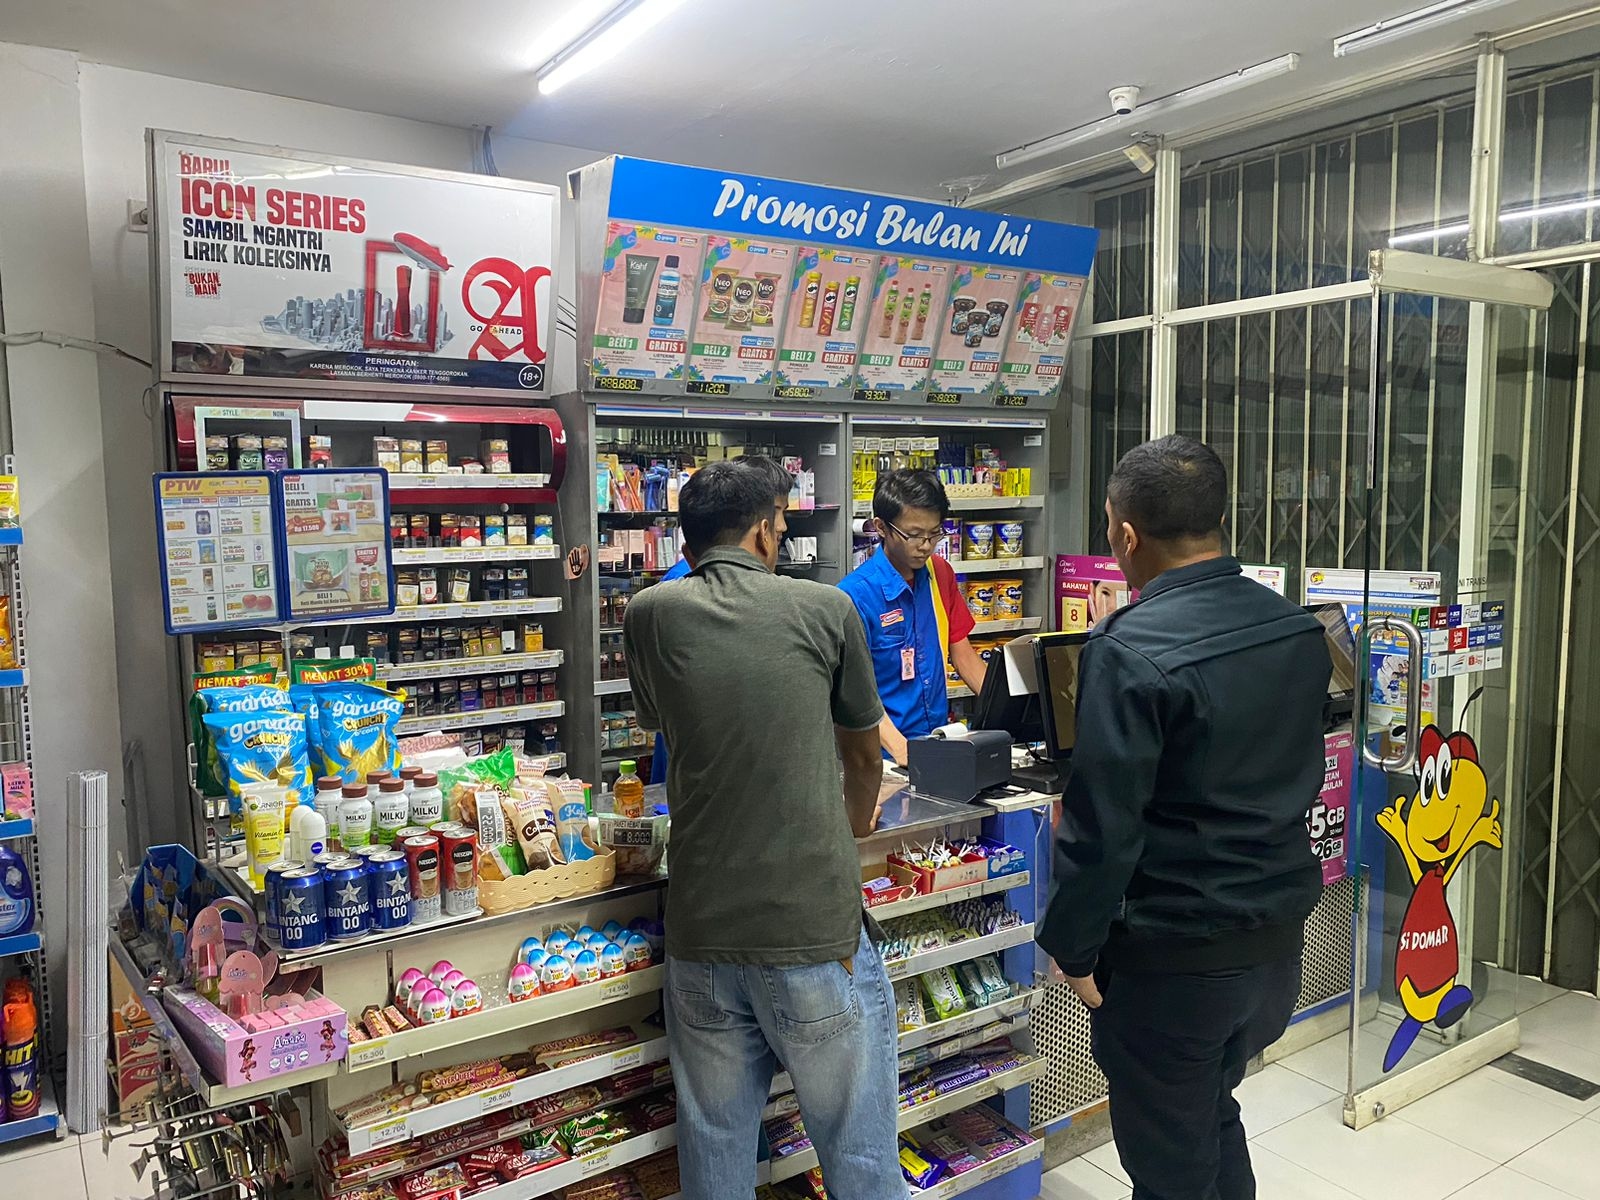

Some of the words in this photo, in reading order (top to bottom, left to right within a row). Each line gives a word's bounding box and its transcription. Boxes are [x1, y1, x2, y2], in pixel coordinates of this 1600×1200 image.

[181, 177, 256, 222] ICON
[266, 188, 366, 234] SERIES
[712, 178, 871, 239] Promosi
[876, 203, 981, 251] Bulan
[988, 220, 1031, 257] Ini
[183, 216, 249, 243] SAMBIL
[253, 224, 323, 251] NGANTRI
[183, 240, 228, 263] LIRIK
[234, 244, 332, 273] KOLEKSINYA
[629, 260, 649, 270] Kahf
[608, 337, 627, 348] BELI
[628, 338, 634, 348] 1
[648, 340, 678, 352] GRATIS
[679, 342, 684, 353] 1
[704, 345, 721, 355] BELI
[722, 346, 727, 355] 2
[741, 348, 768, 359] GRATIS
[769, 350, 774, 359] 1
[790, 350, 806, 360] BELI
[807, 352, 812, 361] 2
[365, 357, 419, 367] PERINGATAN:
[824, 353, 849, 363] GRATIS
[850, 354, 854, 363] 1
[870, 355, 884, 364] BELI
[885, 356, 890, 365] 2
[901, 357, 924, 367] GRATIS
[925, 359, 929, 367] 1
[943, 361, 956, 369] BELI
[957, 362, 961, 370] 2
[971, 362, 992, 371] GRATIS
[994, 363, 998, 371] 1
[1011, 364, 1024, 372] BELI
[1025, 365, 1029, 373] 2
[1037, 366, 1056, 375] GRATIS
[1058, 367, 1062, 375] 1
[521, 371, 540, 382] 18+
[165, 479, 202, 492] PTW
[285, 483, 300, 491] BELI
[301, 482, 305, 491] 1
[286, 498, 311, 507] GRATIS
[1070, 609, 1078, 622] 8
[305, 669, 342, 682] HEMAT
[344, 665, 369, 678] 30%
[198, 676, 241, 688] HEMAT
[244, 674, 268, 686] 30%
[332, 697, 401, 717] garuda
[342, 711, 389, 732] CRUNCHY
[229, 716, 305, 743] garuda
[243, 732, 293, 749] CRUNCHY
[380, 811, 406, 821] MILKU
[412, 805, 439, 816] MILKU
[1326, 806, 1345, 826] GB
[328, 901, 369, 918] BINTANG
[286, 927, 302, 940] 0.0
[1411, 925, 1449, 951] DOMAR
[608, 983, 629, 994] 14.500
[940, 967, 960, 1007] Strepsils
[5, 1044, 34, 1066] HIT
[359, 1049, 384, 1061] 15.300
[434, 1070, 476, 1087] SILVERQUEEN
[488, 1090, 512, 1103] 26.500
[381, 1124, 406, 1137] 12.700
[587, 1154, 608, 1167] 14.200
